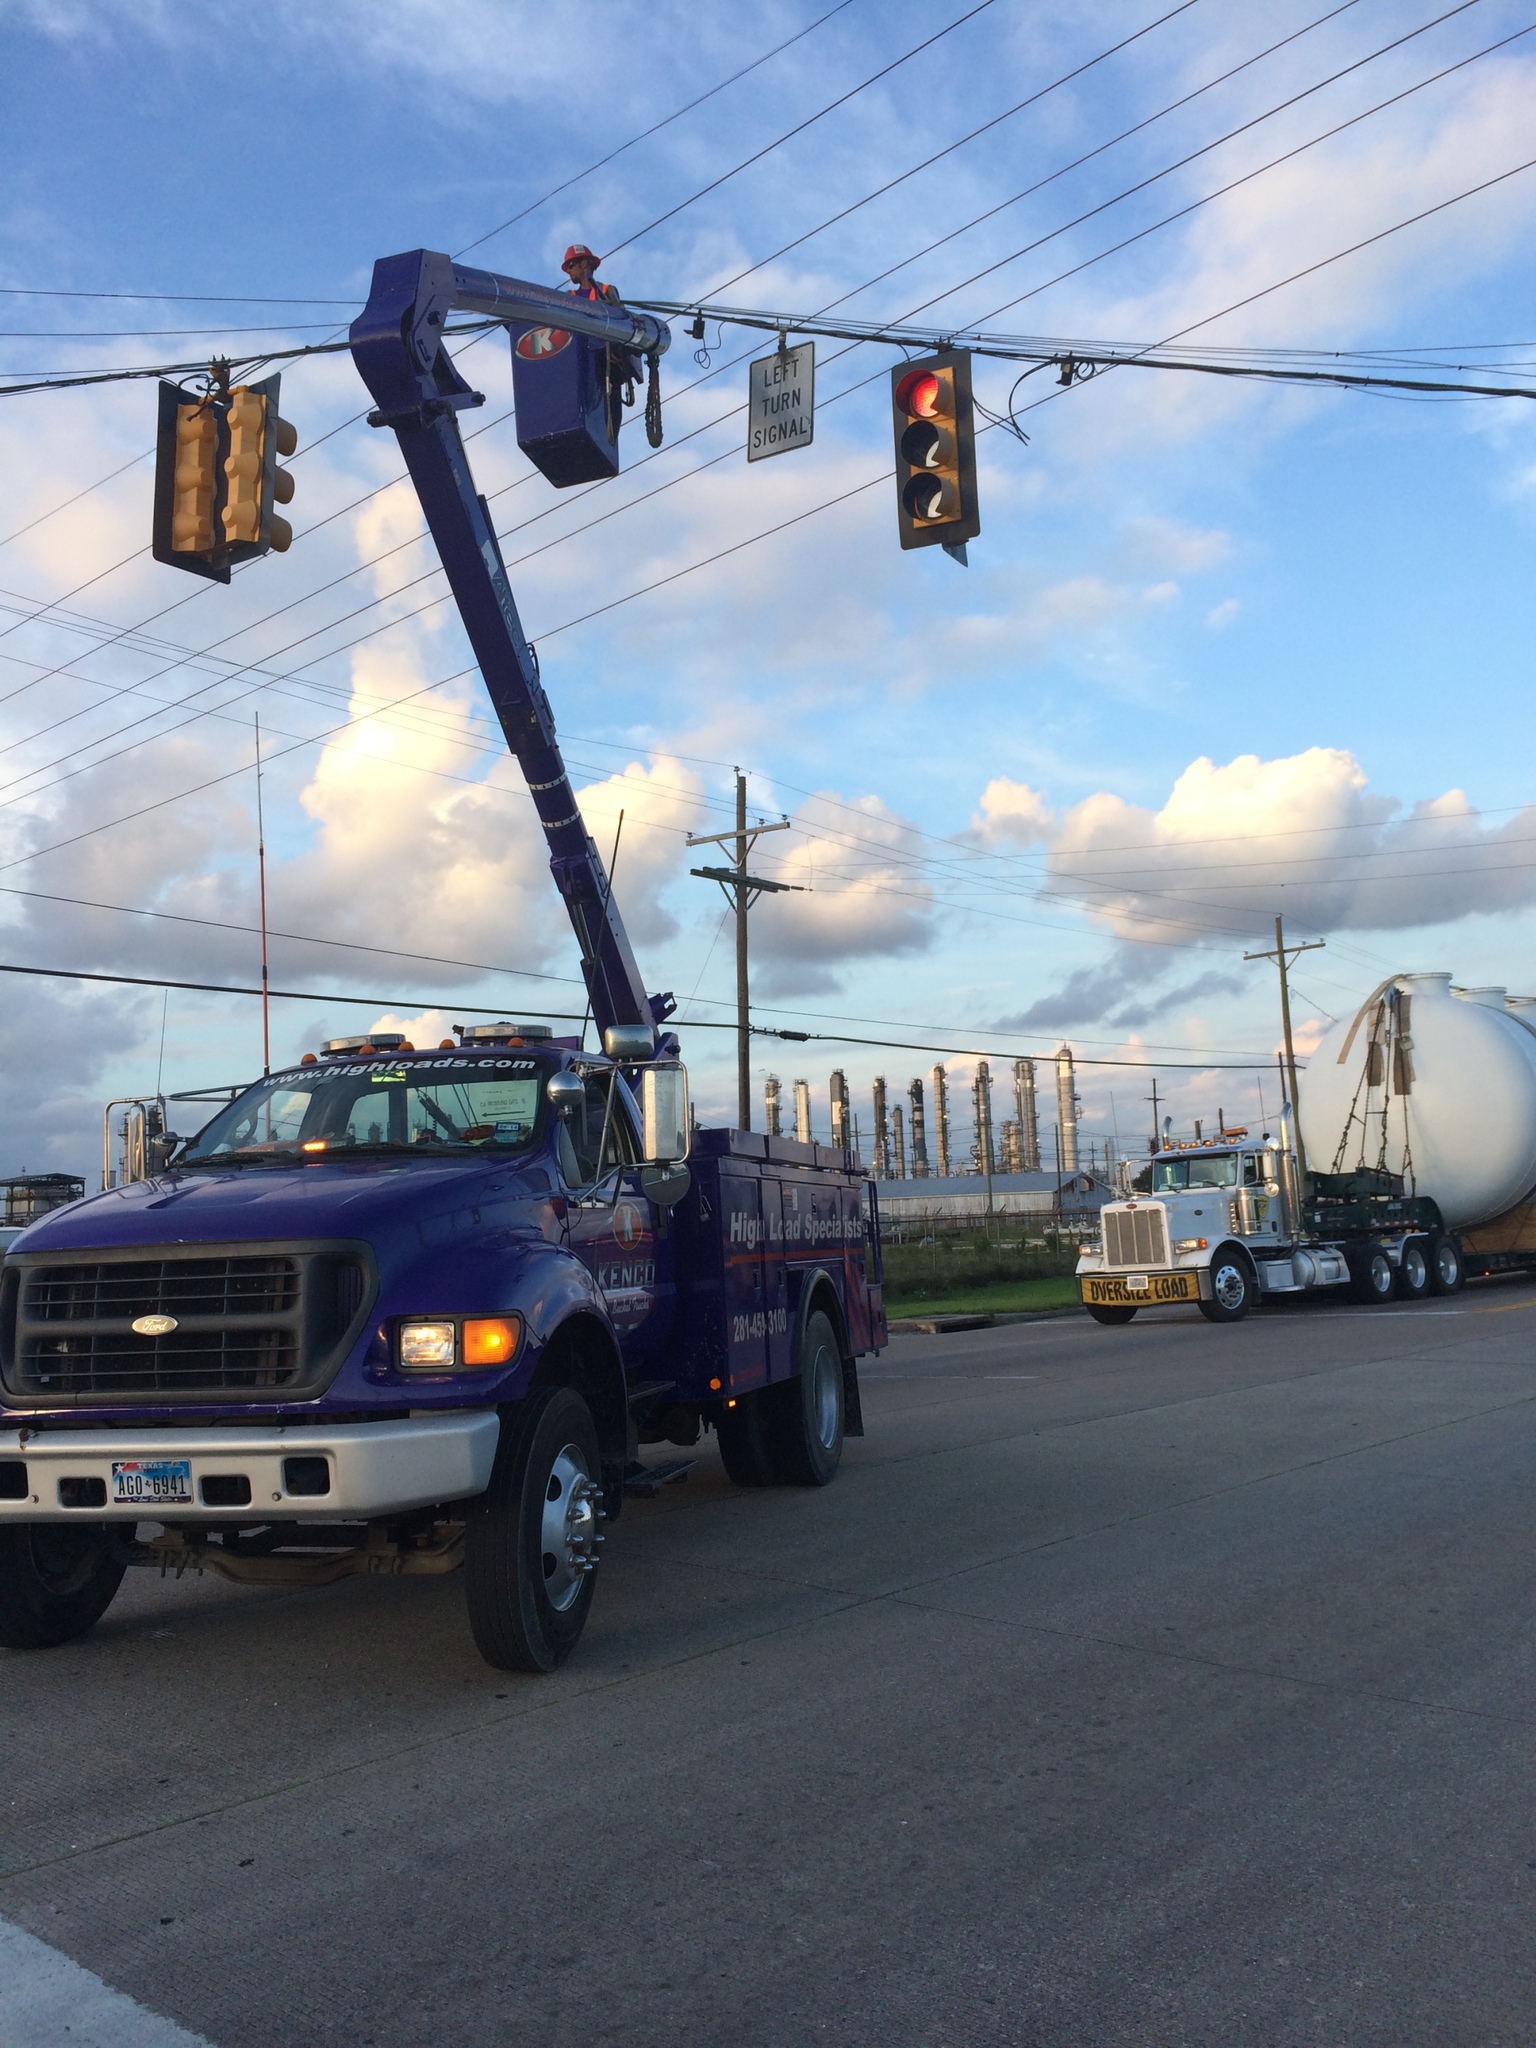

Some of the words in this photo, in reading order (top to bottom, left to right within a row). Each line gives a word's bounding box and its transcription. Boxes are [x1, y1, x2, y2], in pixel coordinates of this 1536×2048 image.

[531, 327, 557, 355] K
[764, 359, 799, 388] LEFT
[762, 388, 801, 417] TURN
[753, 417, 808, 449] SIGNAL
[262, 1057, 536, 1087] www.highloads.com
[730, 1212, 765, 1249] High
[769, 1213, 801, 1240] Load
[804, 1213, 862, 1245] Speciaists
[598, 1259, 656, 1290] KENCO
[1154, 1277, 1189, 1300] LOAD
[141, 1318, 168, 1331] Ford
[153, 1474, 186, 1495] 6941
